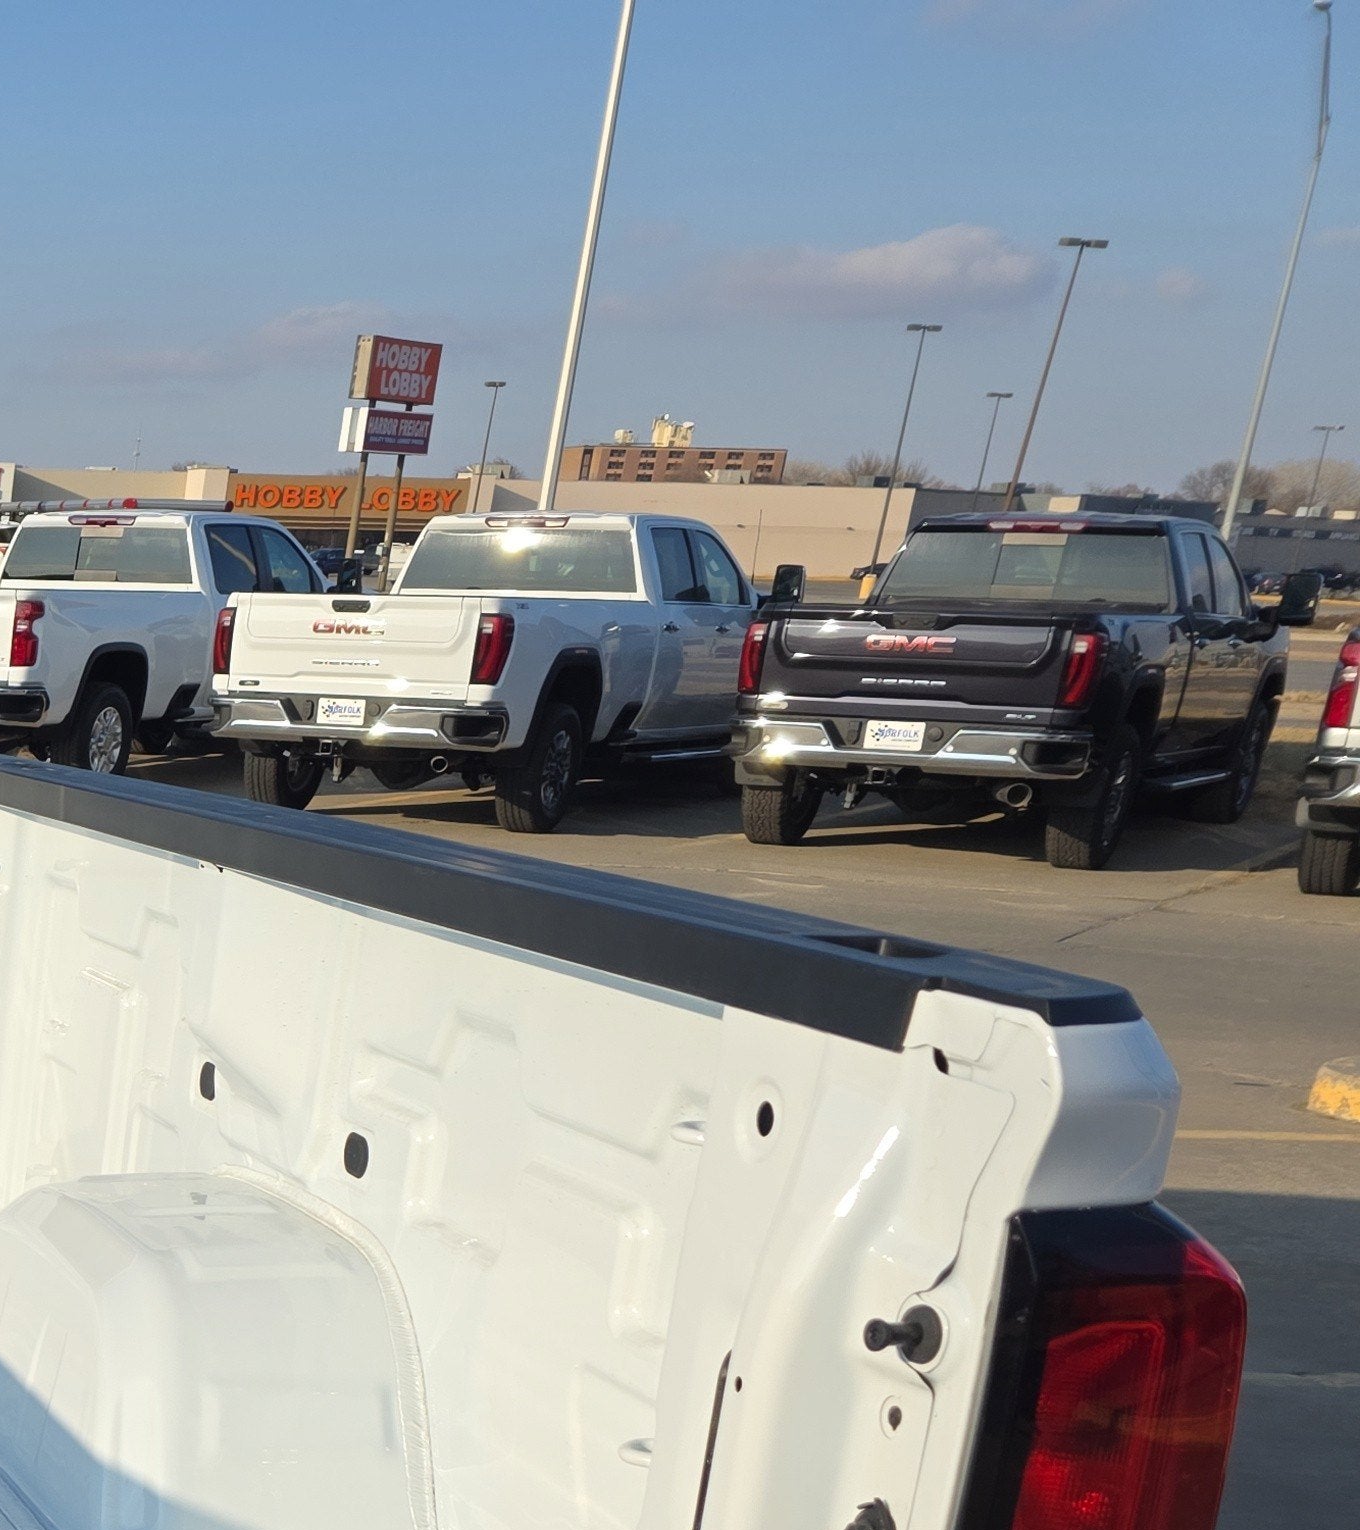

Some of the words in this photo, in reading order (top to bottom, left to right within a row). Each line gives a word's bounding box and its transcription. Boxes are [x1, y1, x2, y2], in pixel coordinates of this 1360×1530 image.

[376, 342, 432, 372] HOBBY
[380, 370, 432, 398] LOBBY
[367, 416, 399, 436] HARBOR
[398, 419, 430, 438] FREIGHT
[235, 484, 347, 508] HOBBY
[312, 618, 386, 636] GMC
[866, 634, 957, 653] GMC
